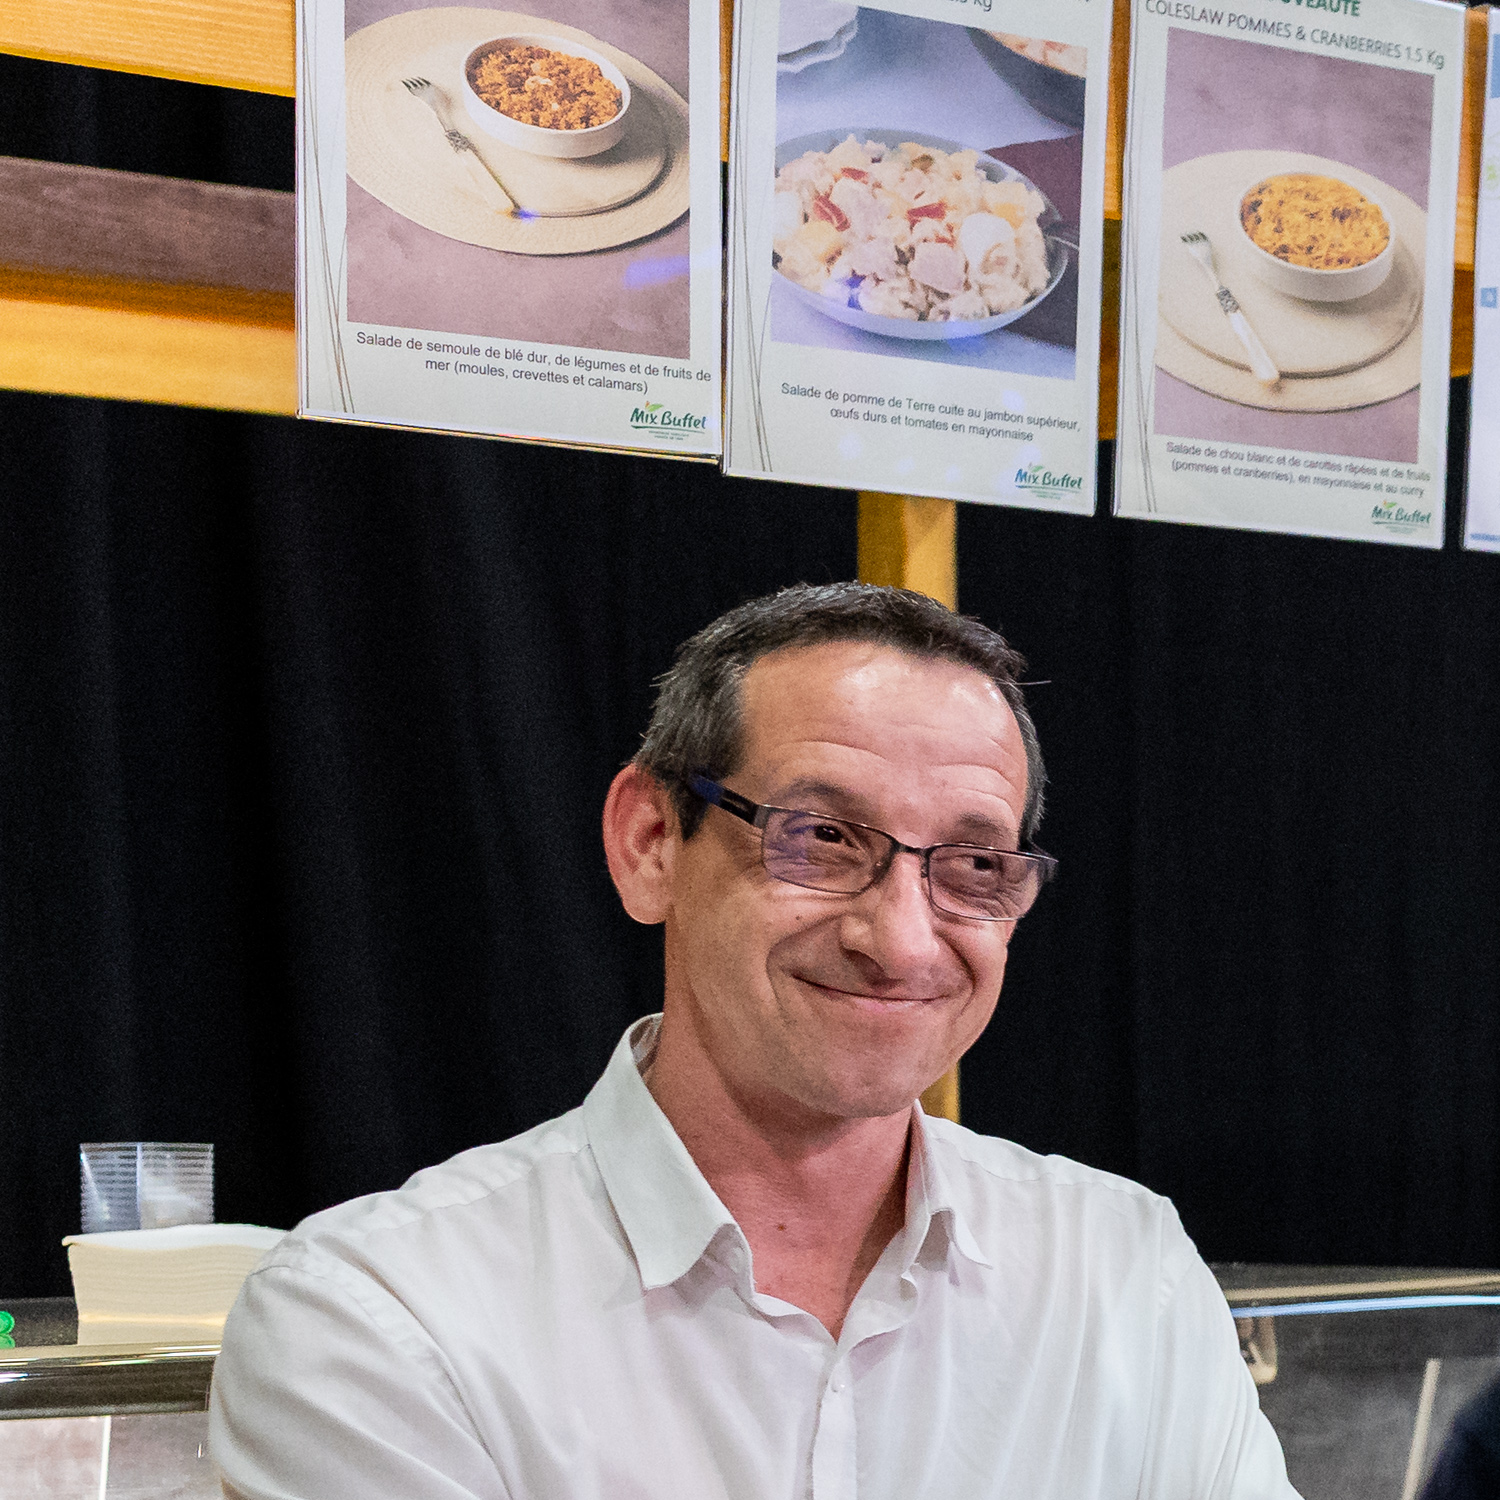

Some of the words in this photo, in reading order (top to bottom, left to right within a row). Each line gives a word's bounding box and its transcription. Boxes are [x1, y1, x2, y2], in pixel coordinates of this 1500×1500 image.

[1146, 0, 1223, 26] COLESLAW
[1229, 13, 1291, 38] POMMES
[1296, 27, 1306, 41] &
[1311, 28, 1401, 58] CRANBERRIES
[356, 332, 402, 349] Salade
[406, 338, 423, 351] de
[426, 340, 480, 357] semoule
[485, 346, 500, 359] de
[505, 347, 523, 362] blé
[527, 350, 551, 366] dur,
[555, 353, 570, 366] de
[574, 355, 626, 374] légumes
[629, 362, 641, 374] et
[645, 363, 659, 376] de
[662, 363, 692, 380] fruits
[696, 368, 711, 382] de
[426, 359, 450, 371] mer
[454, 360, 509, 379] (moules,
[513, 367, 569, 384] crevettes
[573, 374, 585, 386] et
[588, 375, 648, 395] calamars)
[630, 406, 657, 425] Mix
[661, 411, 707, 430] Buffet
[781, 382, 821, 398] Salade
[825, 389, 839, 400] de
[843, 393, 885, 407] pomme
[888, 396, 902, 408] de
[906, 398, 935, 413] Terre
[938, 403, 964, 416] cuite
[967, 408, 981, 418] au
[983, 407, 1023, 424] jambon
[1027, 414, 1080, 432] supérieur,
[830, 407, 859, 420] œufs
[863, 410, 887, 424] durs
[891, 414, 901, 425] et
[905, 416, 948, 431] tomates
[951, 422, 965, 433] en
[969, 425, 1033, 441] mayonnaise
[1014, 468, 1038, 484] Mix
[1042, 471, 1082, 489] Buffet
[1166, 442, 1201, 456] Salade
[1204, 447, 1217, 458] de
[1220, 449, 1244, 462] chou
[1247, 452, 1273, 464] blanc
[1277, 455, 1285, 465] et
[1288, 456, 1300, 467] de
[1304, 458, 1342, 473] carottes
[1380, 467, 1389, 476] et
[1391, 467, 1404, 478] de
[1406, 469, 1430, 482] fruits
[1172, 459, 1218, 475] (pommes
[1221, 465, 1231, 475] et
[1299, 474, 1311, 483] en
[1313, 476, 1371, 490] mayonnaise
[1374, 483, 1383, 492] et
[1386, 485, 1397, 494] au
[1400, 487, 1424, 498] curry
[1372, 505, 1391, 520] Mix
[1395, 507, 1431, 523] Buffet
